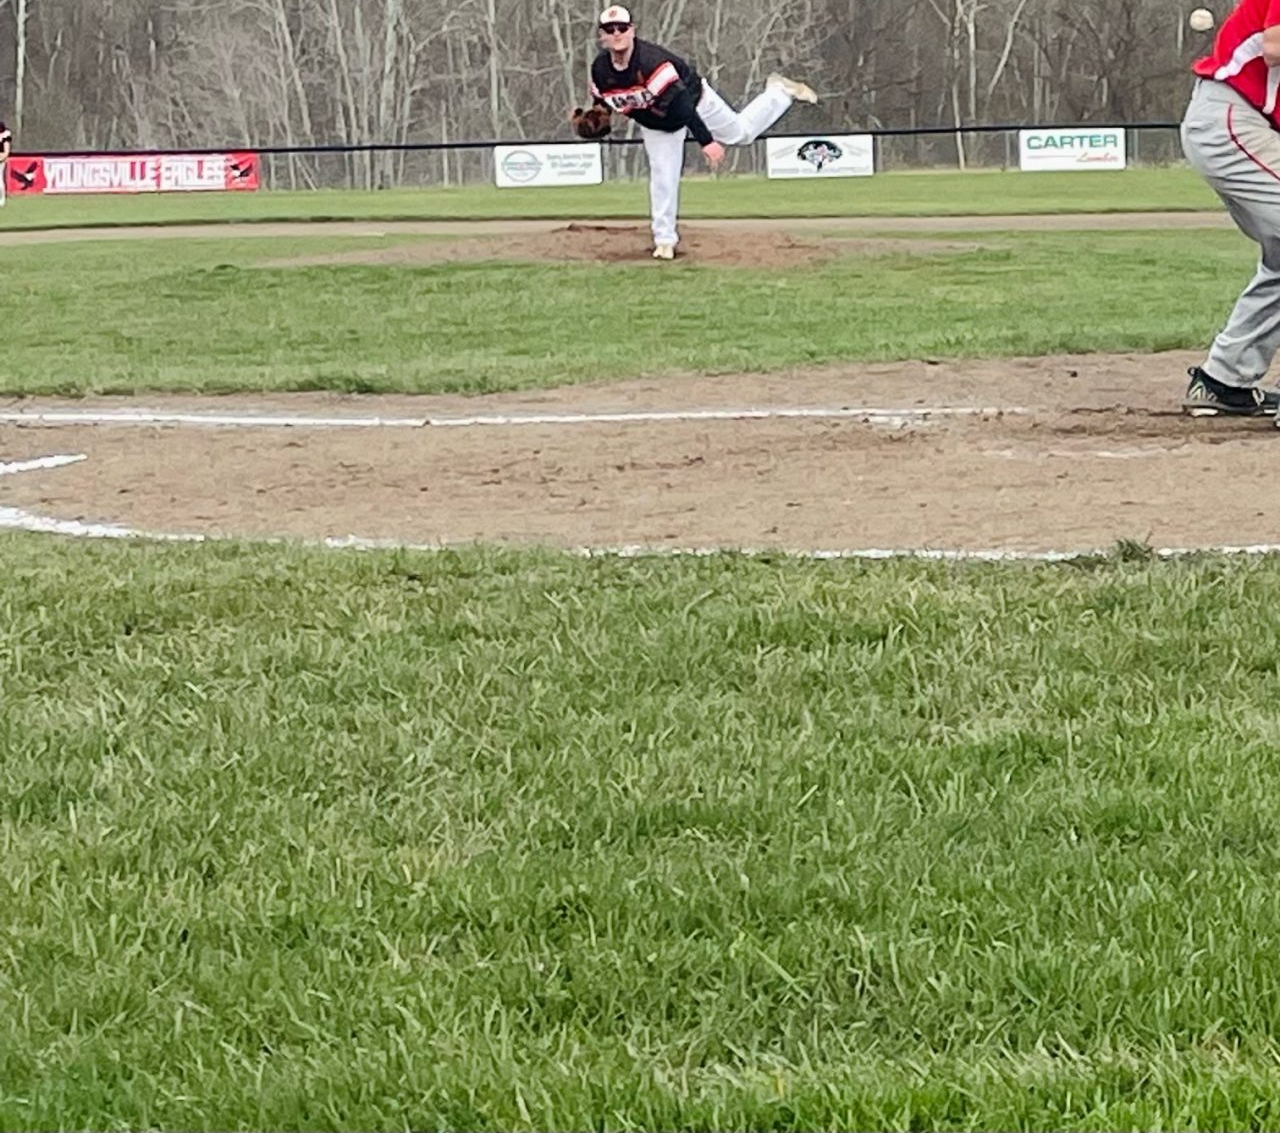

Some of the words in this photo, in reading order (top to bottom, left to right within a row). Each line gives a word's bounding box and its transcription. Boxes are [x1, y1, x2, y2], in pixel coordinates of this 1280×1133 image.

[1026, 134, 1118, 150] CARTER
[44, 160, 159, 190] YOUNGSVILLE
[161, 157, 226, 189] EAGLES
